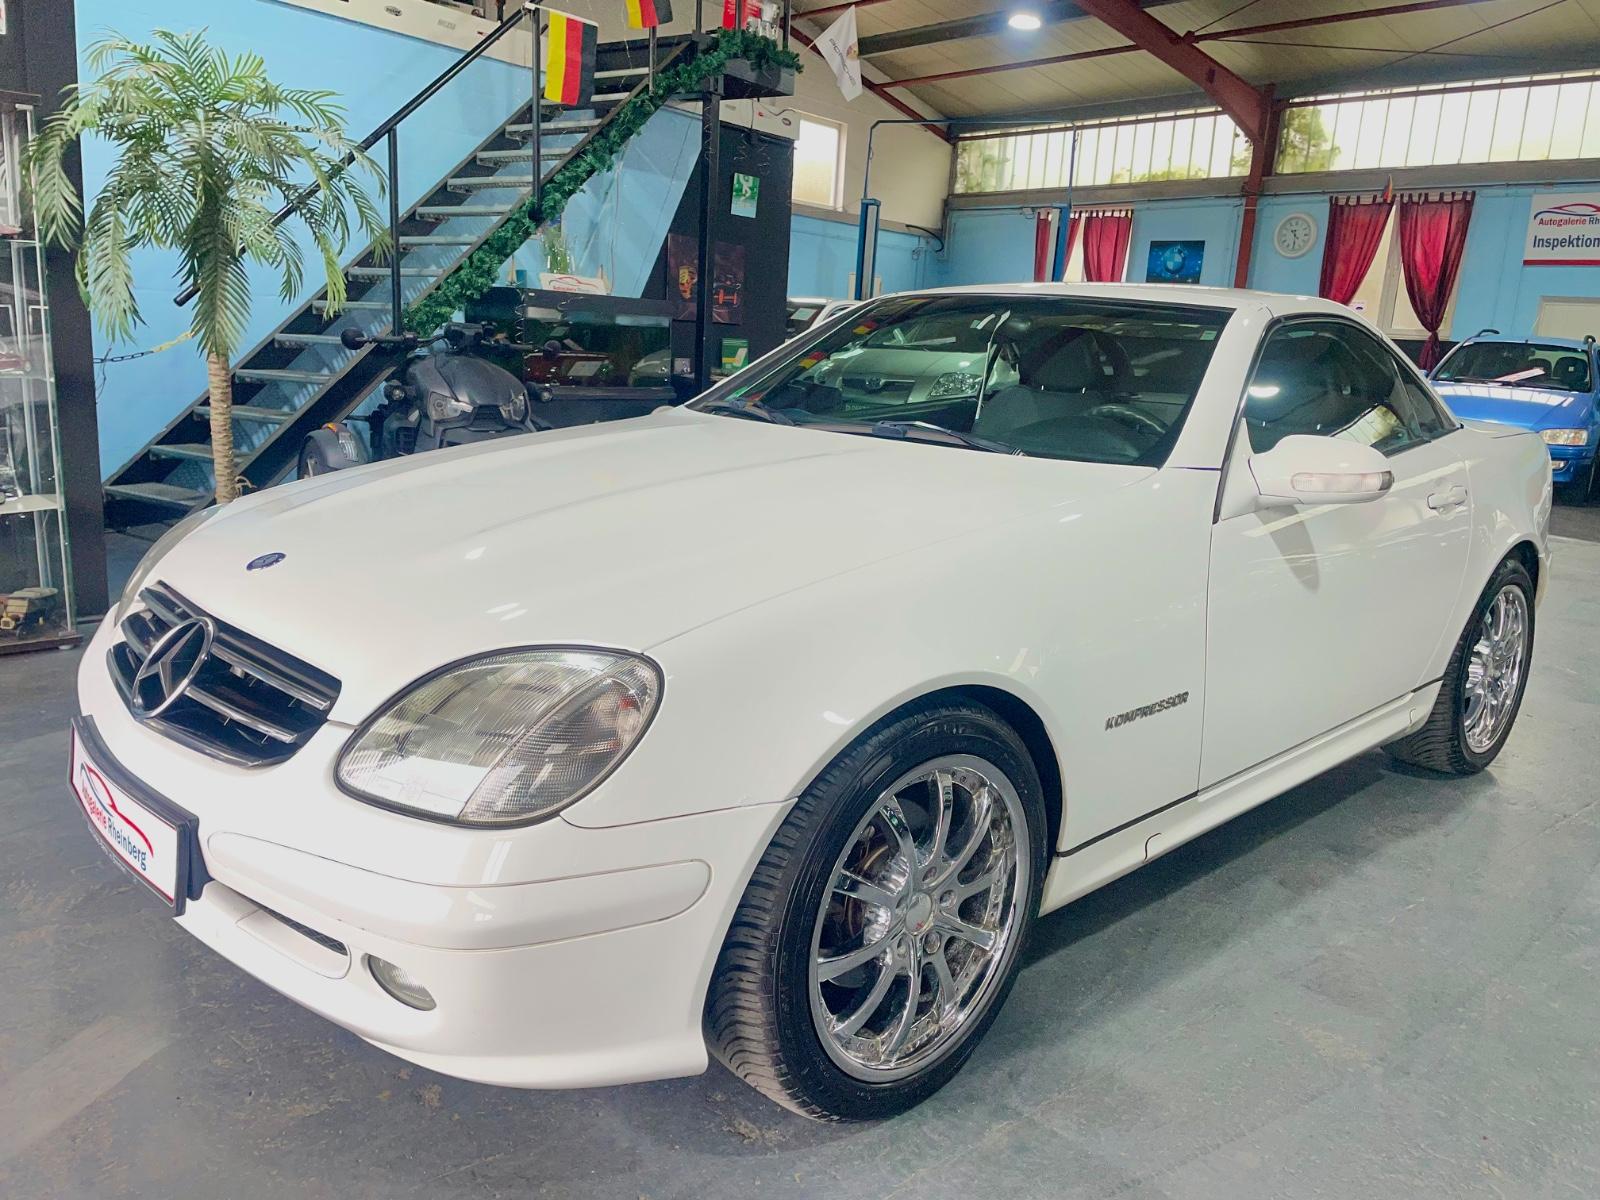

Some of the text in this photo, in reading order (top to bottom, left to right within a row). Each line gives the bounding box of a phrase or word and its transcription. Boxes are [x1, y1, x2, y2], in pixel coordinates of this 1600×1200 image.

[1538, 217, 1587, 228] Autogalerie
[1533, 234, 1600, 251] Inspektion
[1105, 691, 1189, 731] KOMPRESSOR
[107, 817, 147, 872] Rheinberg
